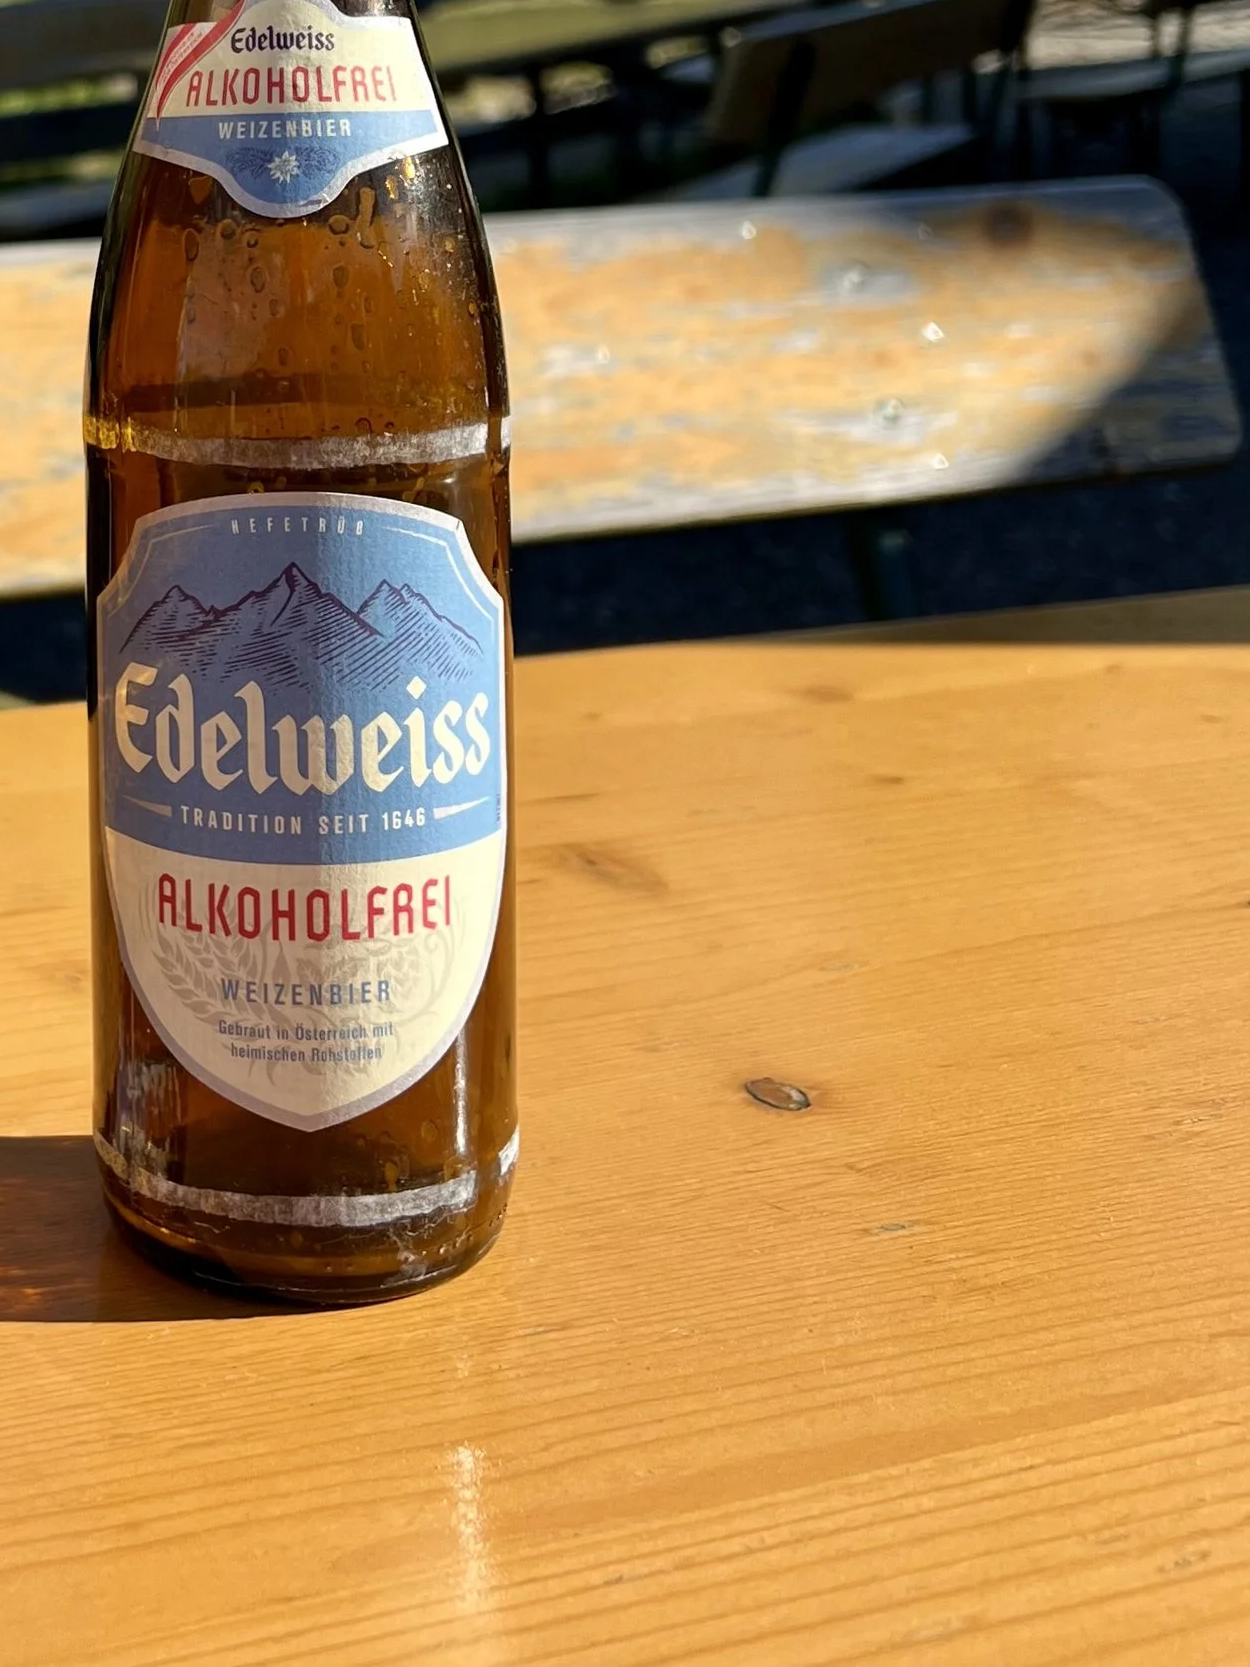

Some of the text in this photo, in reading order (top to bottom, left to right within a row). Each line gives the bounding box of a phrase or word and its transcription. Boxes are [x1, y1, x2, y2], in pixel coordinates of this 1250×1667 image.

[230, 25, 335, 53] Edelweiss
[186, 65, 397, 107] ALKOHOLFREI
[218, 119, 352, 140] WEIZENBIER
[231, 516, 364, 536] HEFETRÜB
[115, 662, 491, 795] Edelweiss
[180, 805, 426, 835] TRADITION SEIT 1646
[158, 872, 451, 942] ALKOHOLFREI
[221, 978, 391, 1006] WEIZENBIER
[218, 1019, 394, 1041] Gebraut in Österreich mit
[231, 1042, 382, 1063] heimischen Rohstoffen
